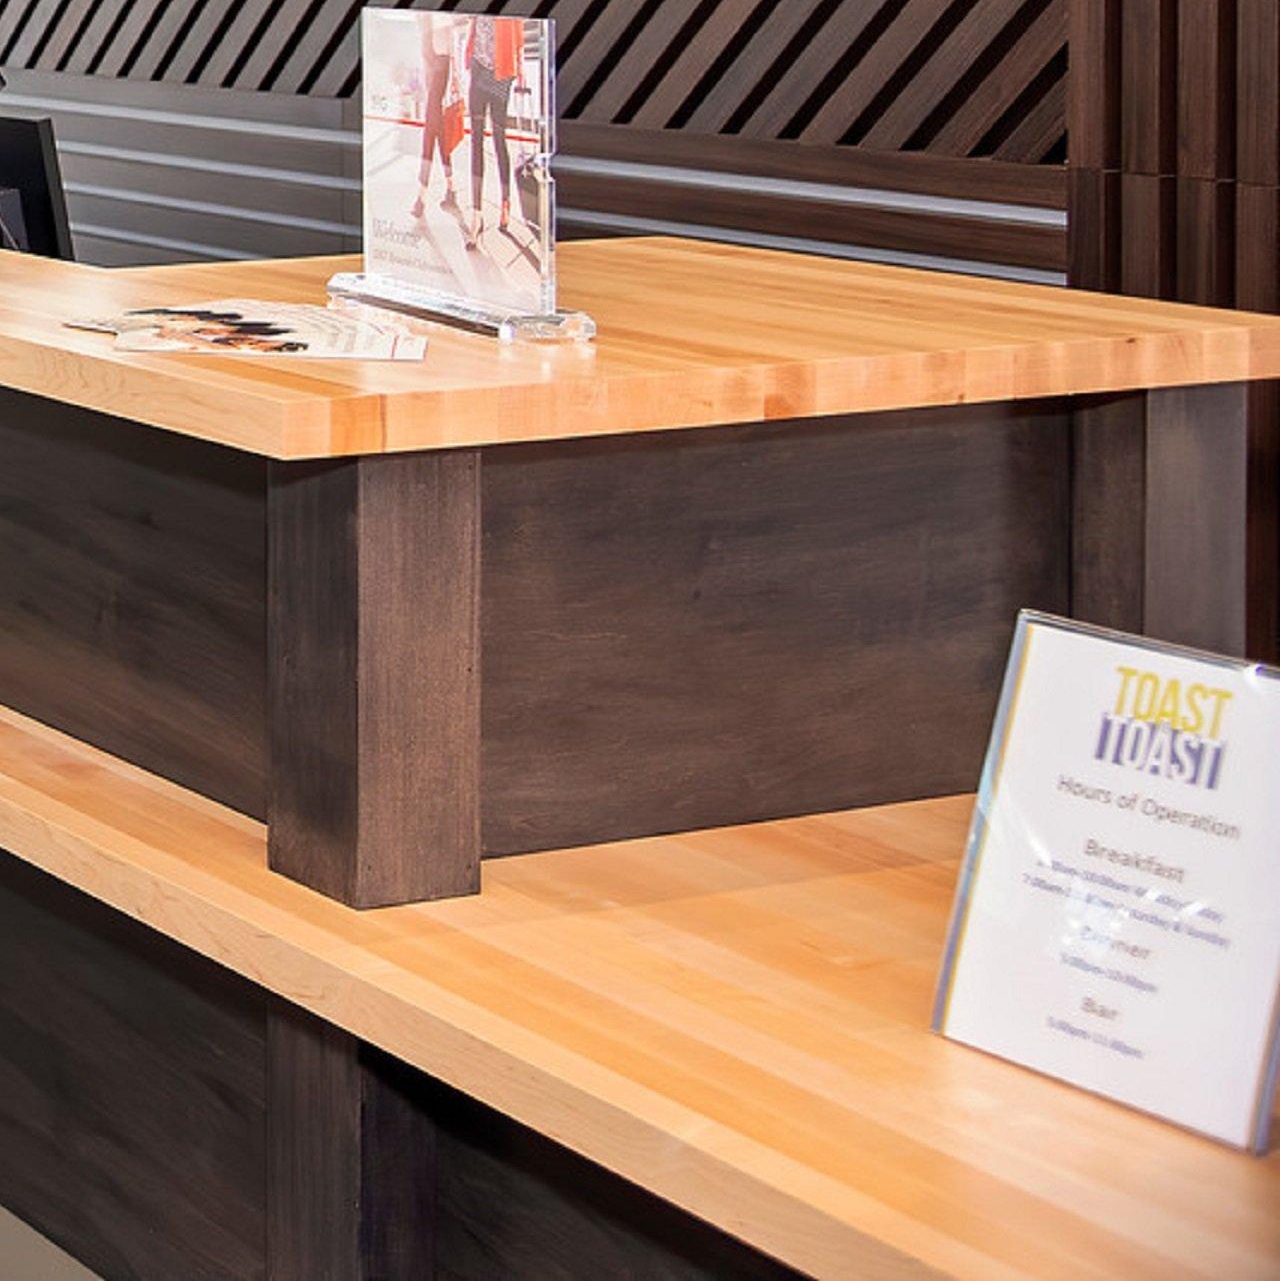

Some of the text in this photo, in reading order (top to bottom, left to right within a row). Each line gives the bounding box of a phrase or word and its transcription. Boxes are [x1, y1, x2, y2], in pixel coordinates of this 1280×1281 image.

[1114, 666, 1233, 740] TOAST
[1057, 774, 1240, 839] Hours of Operation
[1084, 838, 1185, 883] Breakfast
[1081, 996, 1120, 1019] Bar
